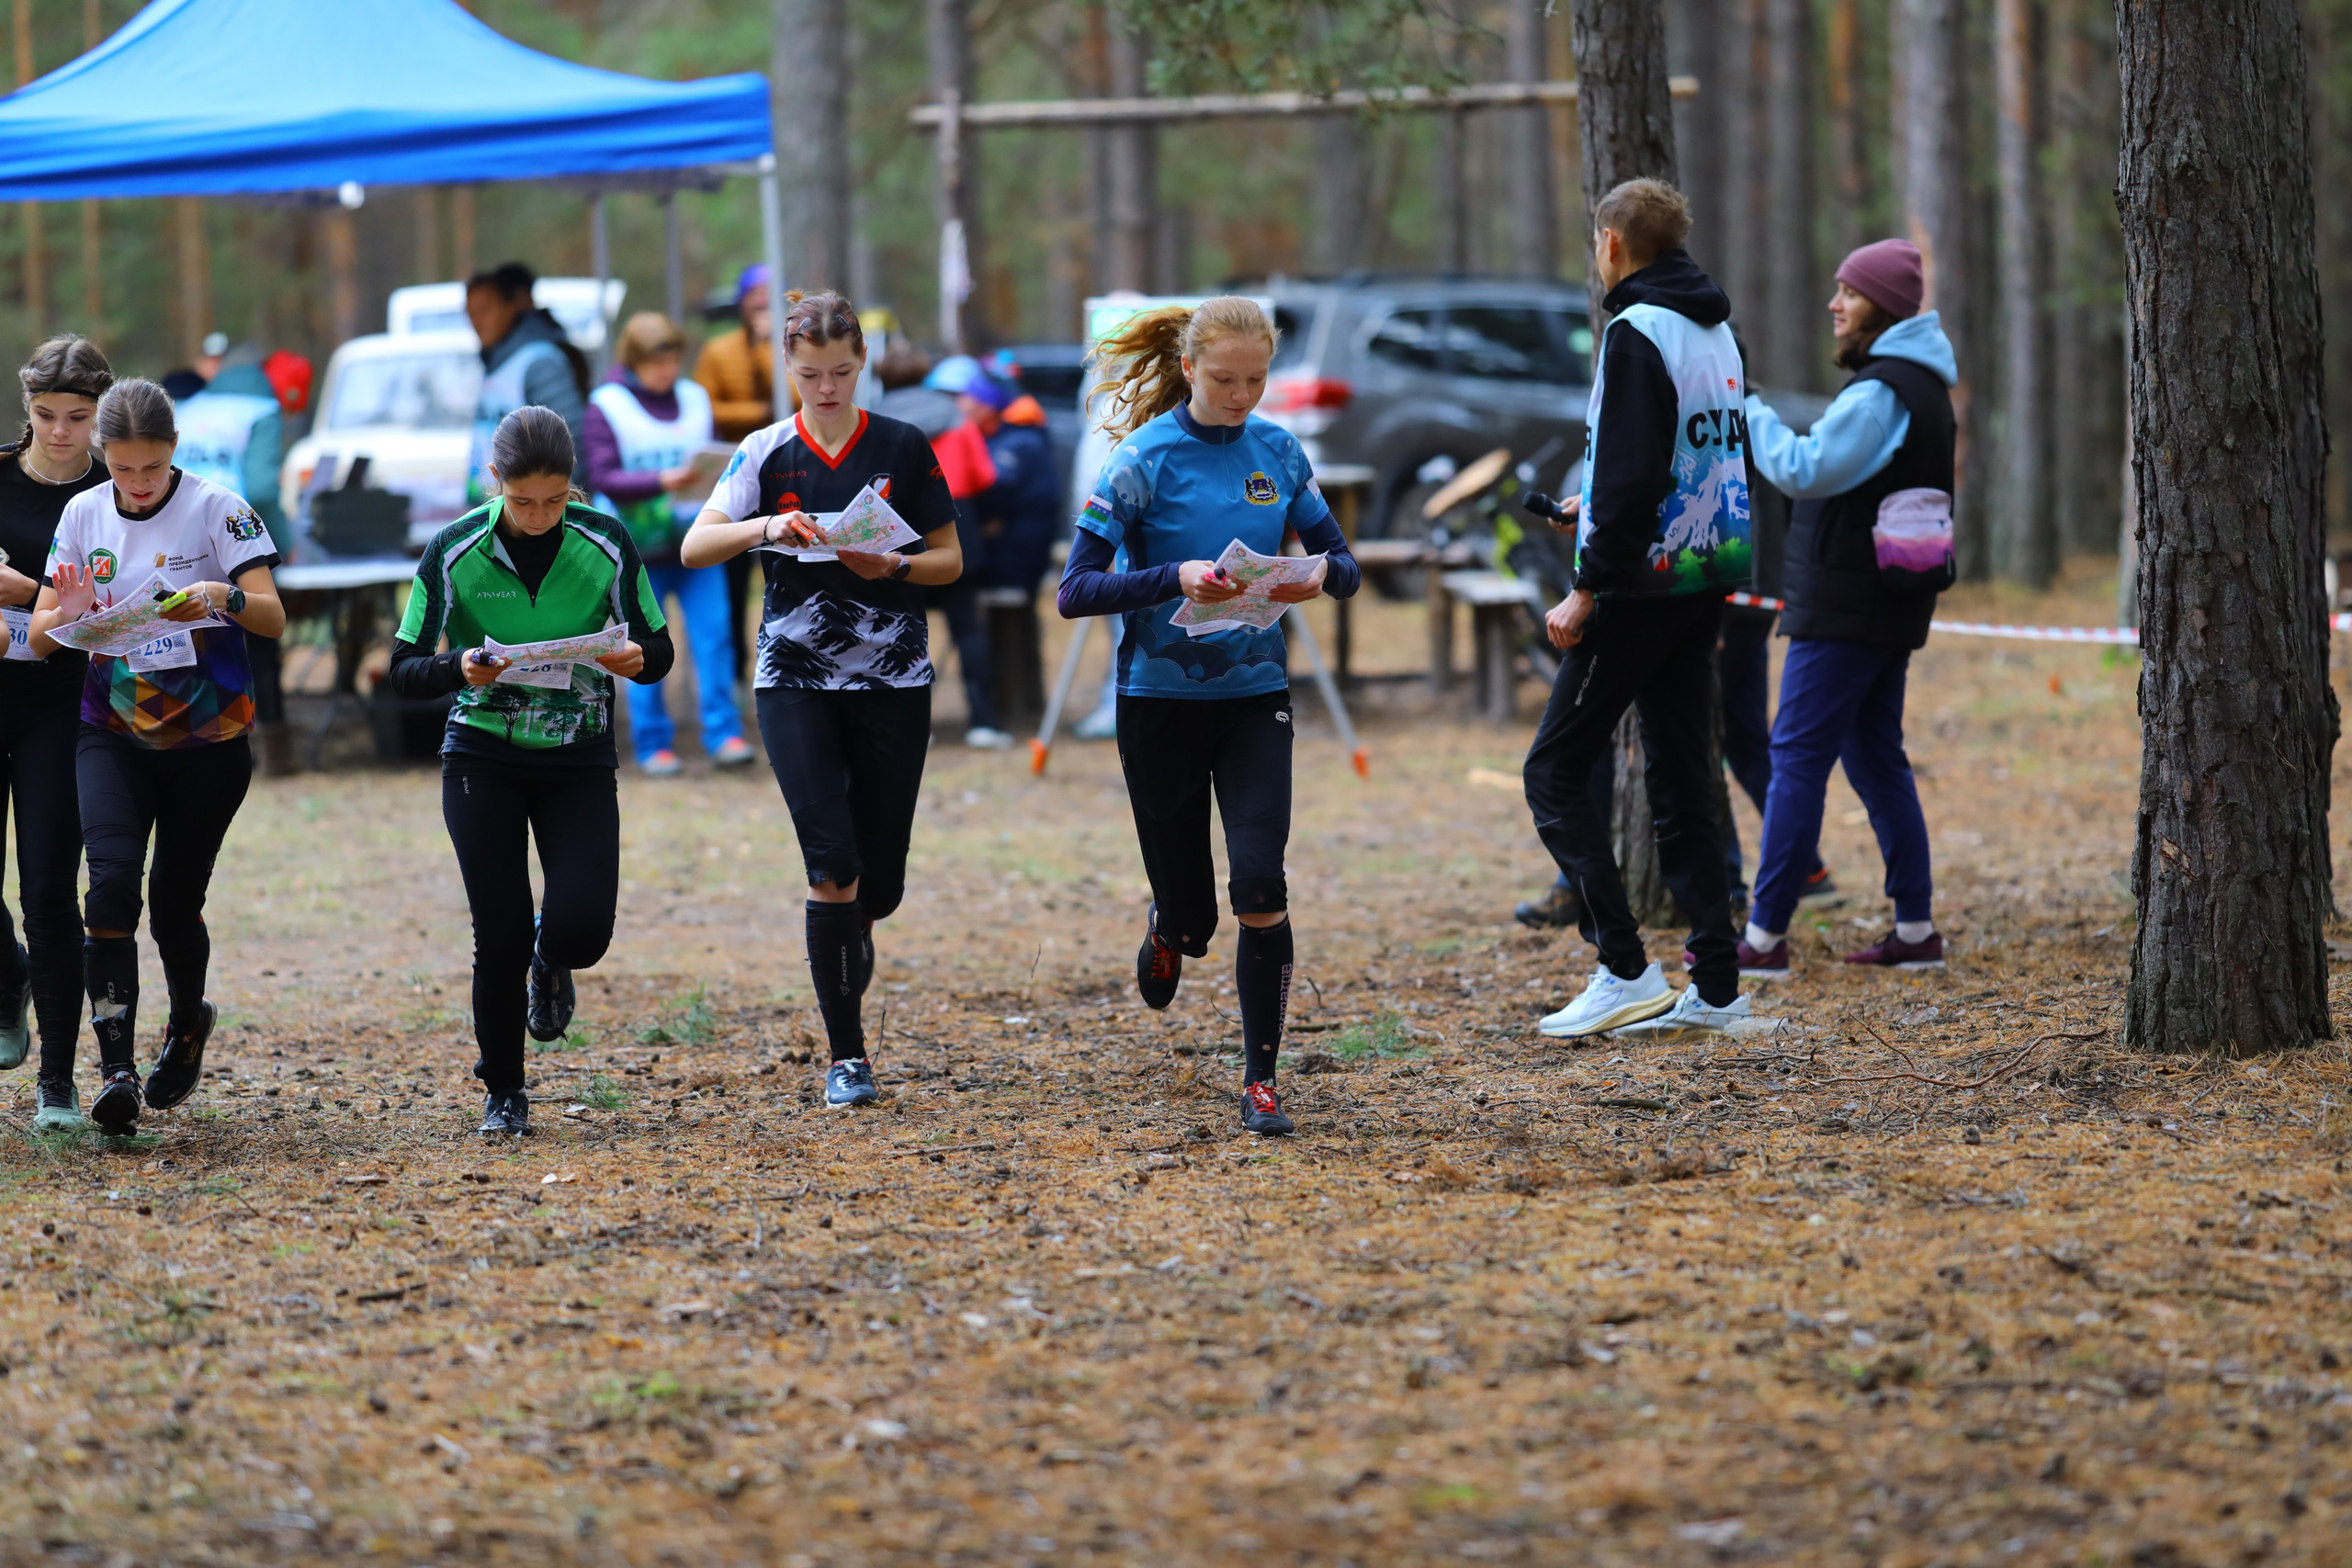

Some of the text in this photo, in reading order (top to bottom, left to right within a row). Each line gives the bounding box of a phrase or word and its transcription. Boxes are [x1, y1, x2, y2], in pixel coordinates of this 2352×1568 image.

[1687, 409, 1745, 452] СУД
[168, 553, 209, 567] ПРЕЗИДЕНТСКИХ
[169, 564, 193, 572] ГРАНТОВ
[476, 591, 516, 599] ARSWEAR
[9, 627, 28, 646] 30
[143, 637, 173, 657] 229
